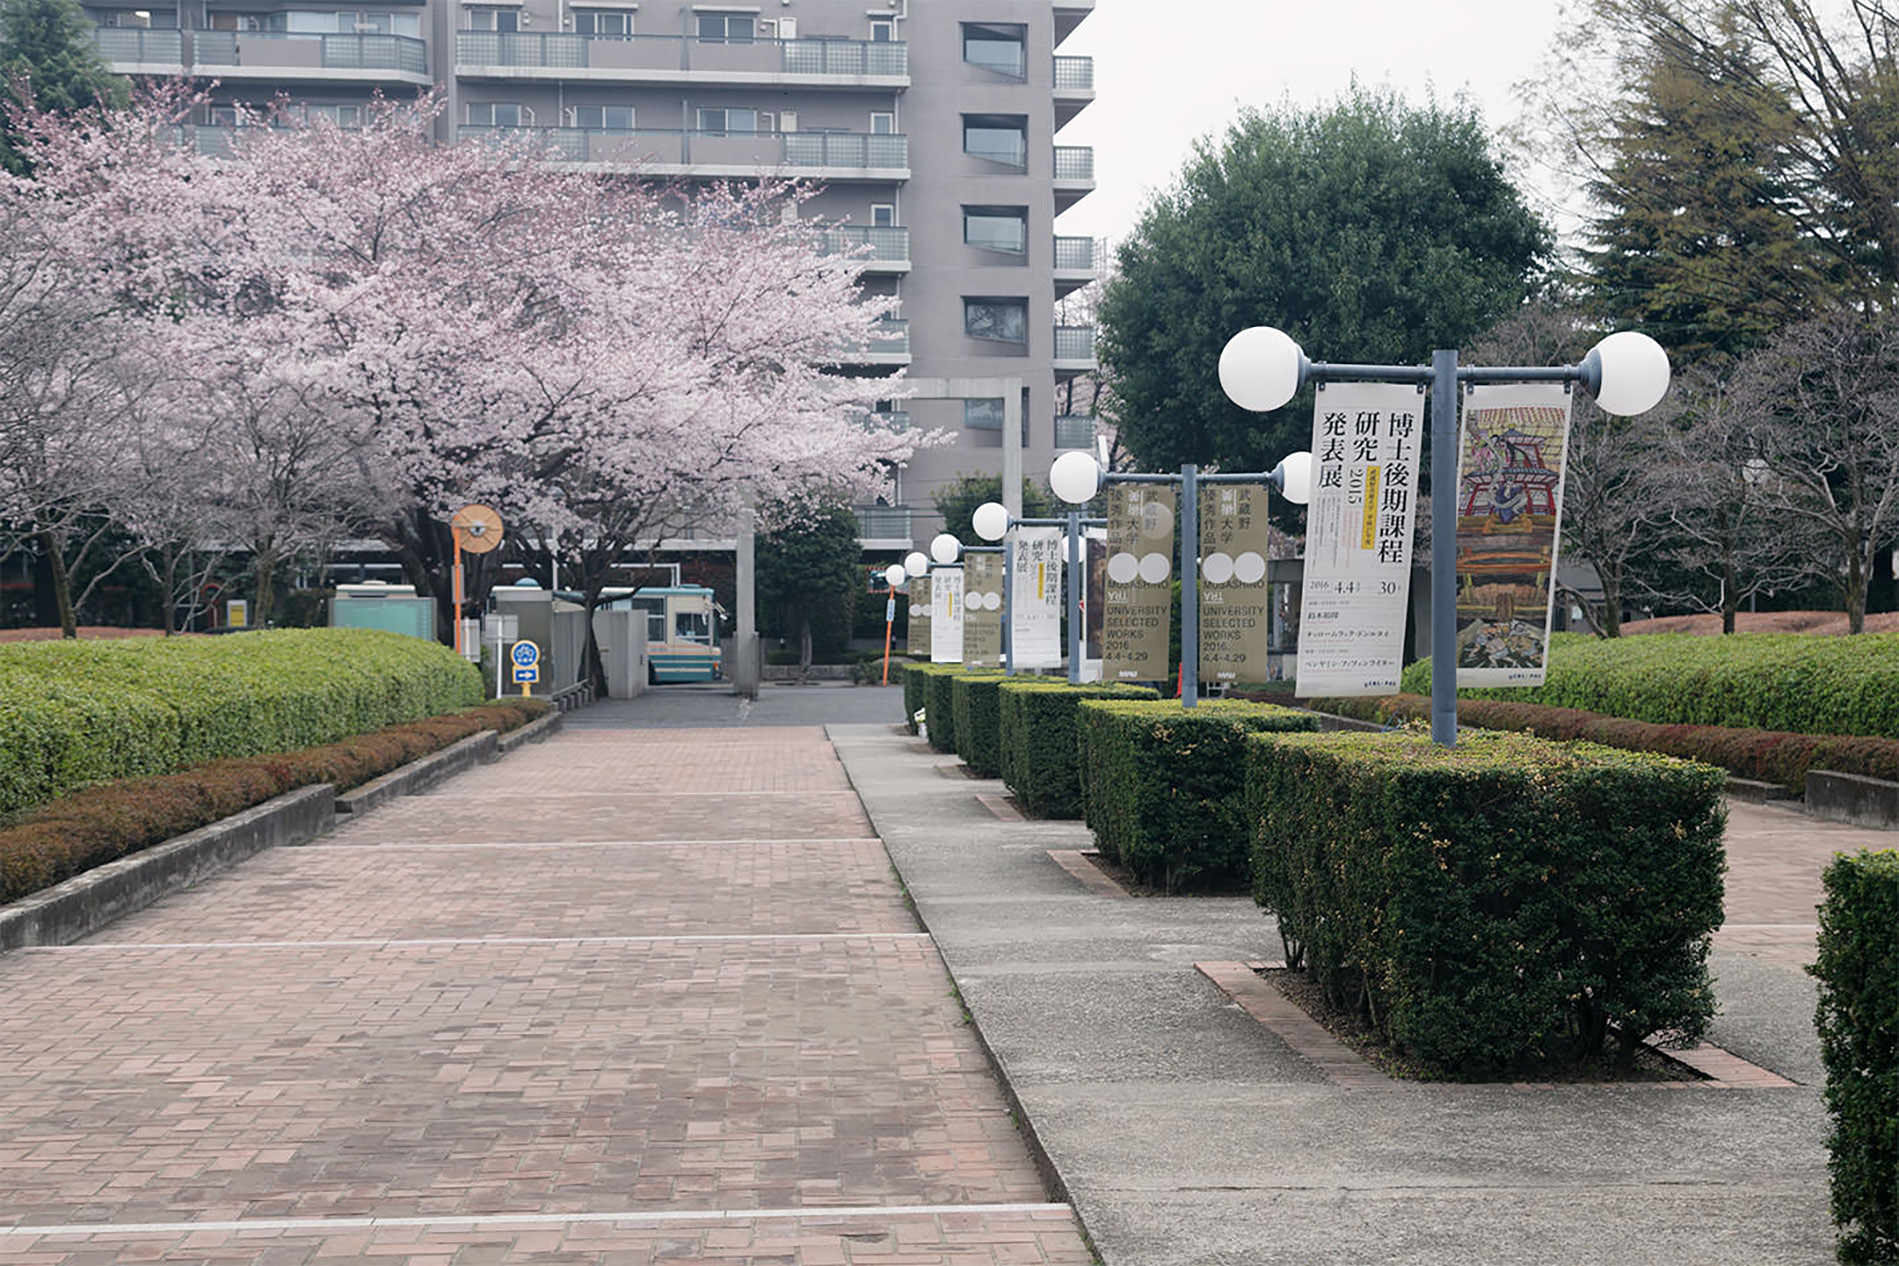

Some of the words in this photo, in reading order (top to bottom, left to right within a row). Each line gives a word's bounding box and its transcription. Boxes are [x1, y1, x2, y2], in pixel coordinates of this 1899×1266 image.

[1353, 411, 1380, 462] 研究
[1318, 412, 1346, 489] 発表展
[1347, 469, 1363, 505] 2015
[1377, 413, 1413, 565] 博士後期課程
[1106, 606, 1168, 616] UNIVERSITY
[1203, 606, 1264, 616] UNIVERSITY
[1106, 617, 1160, 628] SELECTED
[1202, 617, 1256, 628] SELECTED
[1106, 630, 1145, 640] WORKS
[1203, 630, 1242, 640] WORKS
